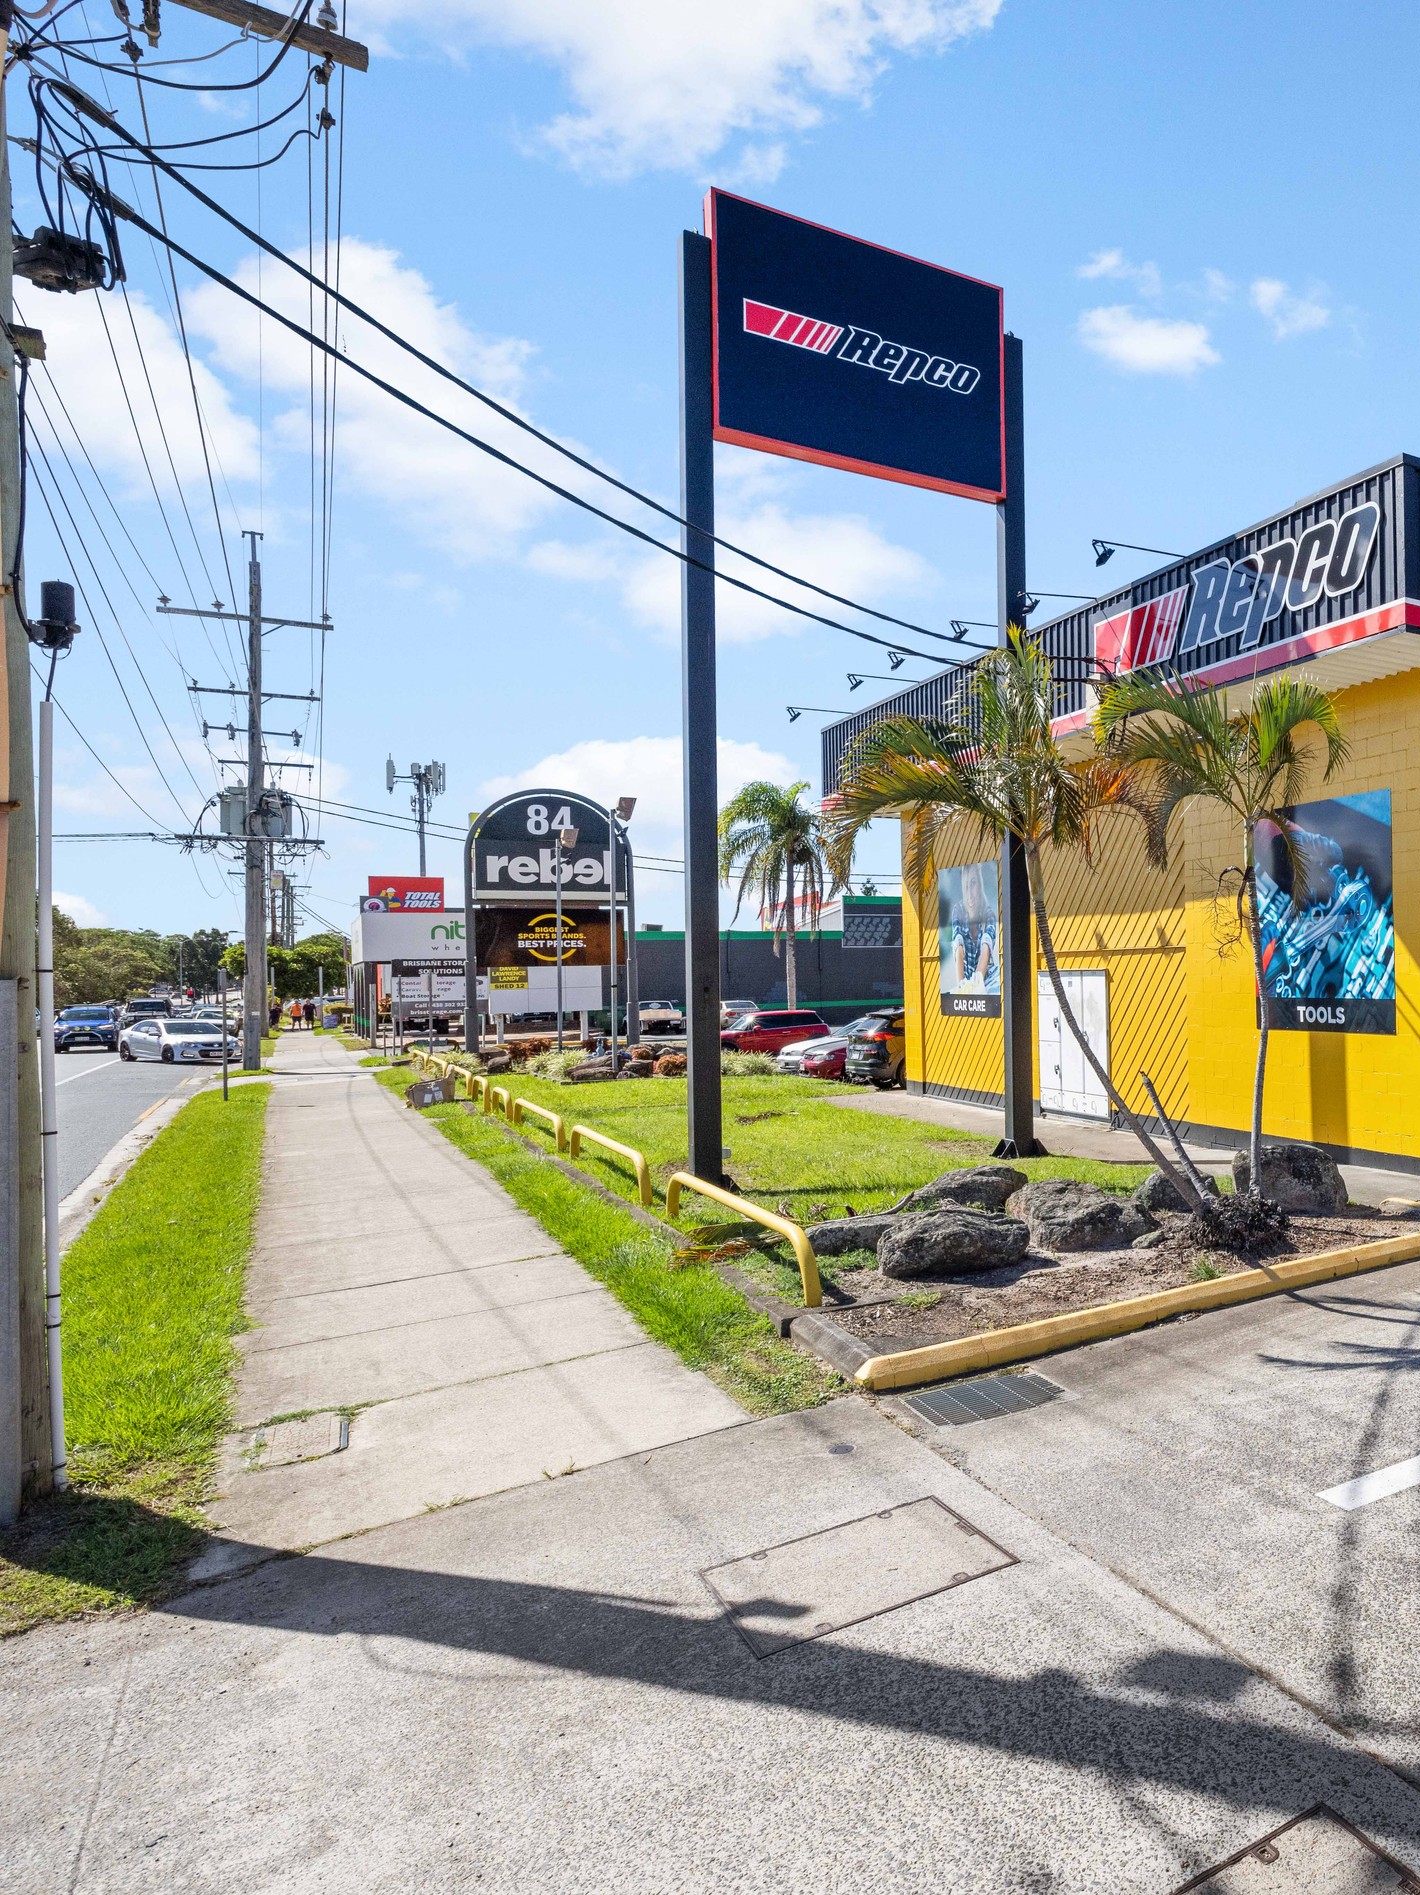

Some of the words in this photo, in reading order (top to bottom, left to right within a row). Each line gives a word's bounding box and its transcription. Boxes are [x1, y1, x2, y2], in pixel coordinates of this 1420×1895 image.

[836, 324, 981, 395] Repco
[1178, 500, 1381, 656] Repco
[526, 804, 574, 835] 84
[486, 848, 611, 885] rebel
[403, 900, 442, 908] TOOLS
[404, 891, 441, 900] TOTAL
[431, 920, 466, 940] nit
[517, 940, 546, 948] BEST
[953, 999, 968, 1011] CAR
[968, 999, 986, 1012] CARE
[1296, 1005, 1346, 1025] TOOLS
